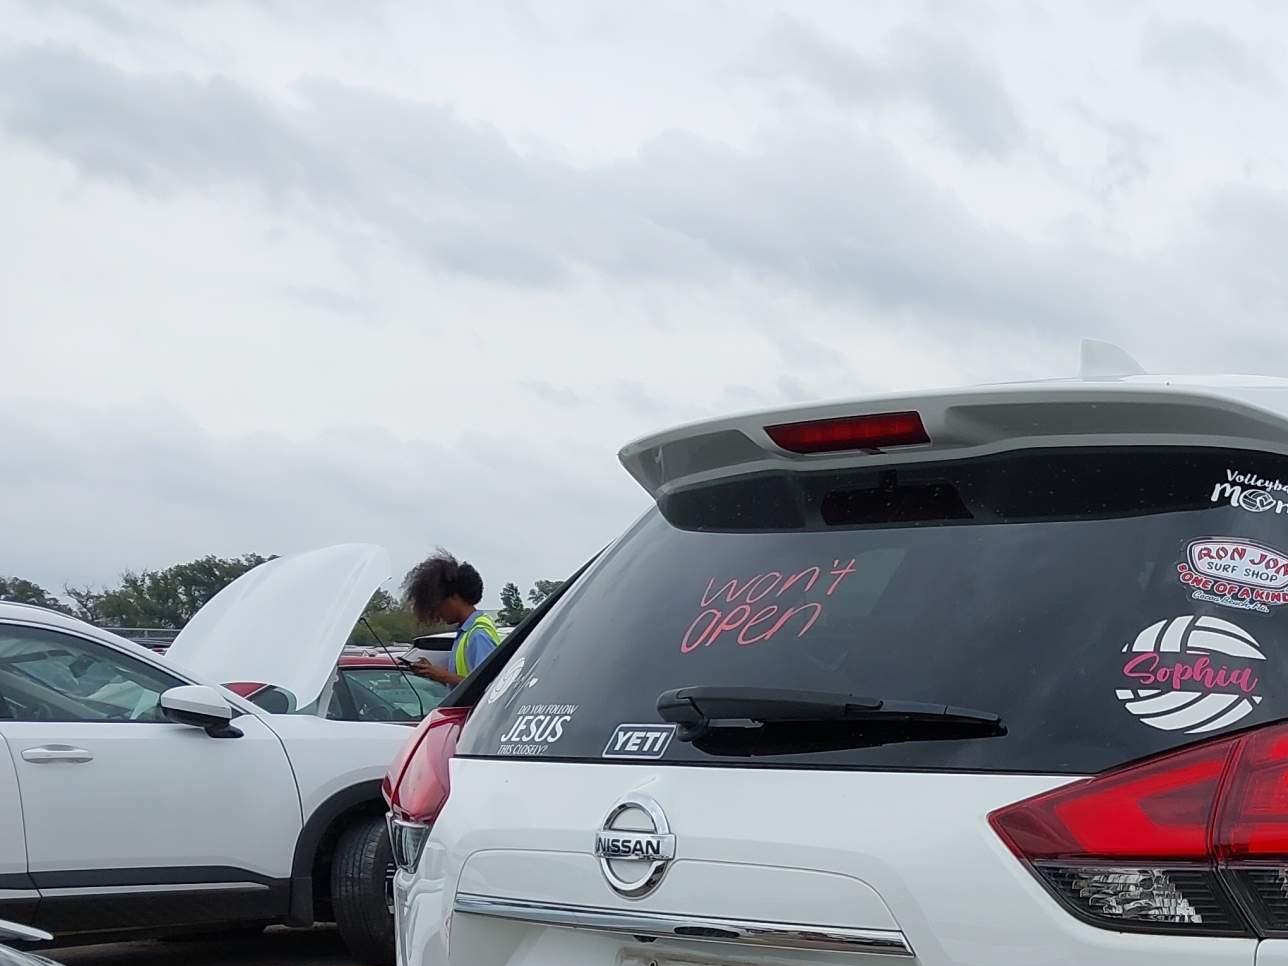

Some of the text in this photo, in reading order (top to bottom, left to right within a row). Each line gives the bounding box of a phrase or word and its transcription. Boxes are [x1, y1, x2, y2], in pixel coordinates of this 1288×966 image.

[1197, 546, 1247, 561] RON
[1207, 561, 1278, 583] SURF SHOP
[1215, 582, 1238, 596] OF
[1239, 587, 1251, 599] A
[1123, 652, 1258, 693] Sophia
[518, 704, 578, 714] DO YOU FOLLOW
[501, 715, 571, 742] JESUS
[497, 744, 514, 755] THIS
[614, 731, 669, 752] YETI
[595, 836, 661, 855] NISSAN
